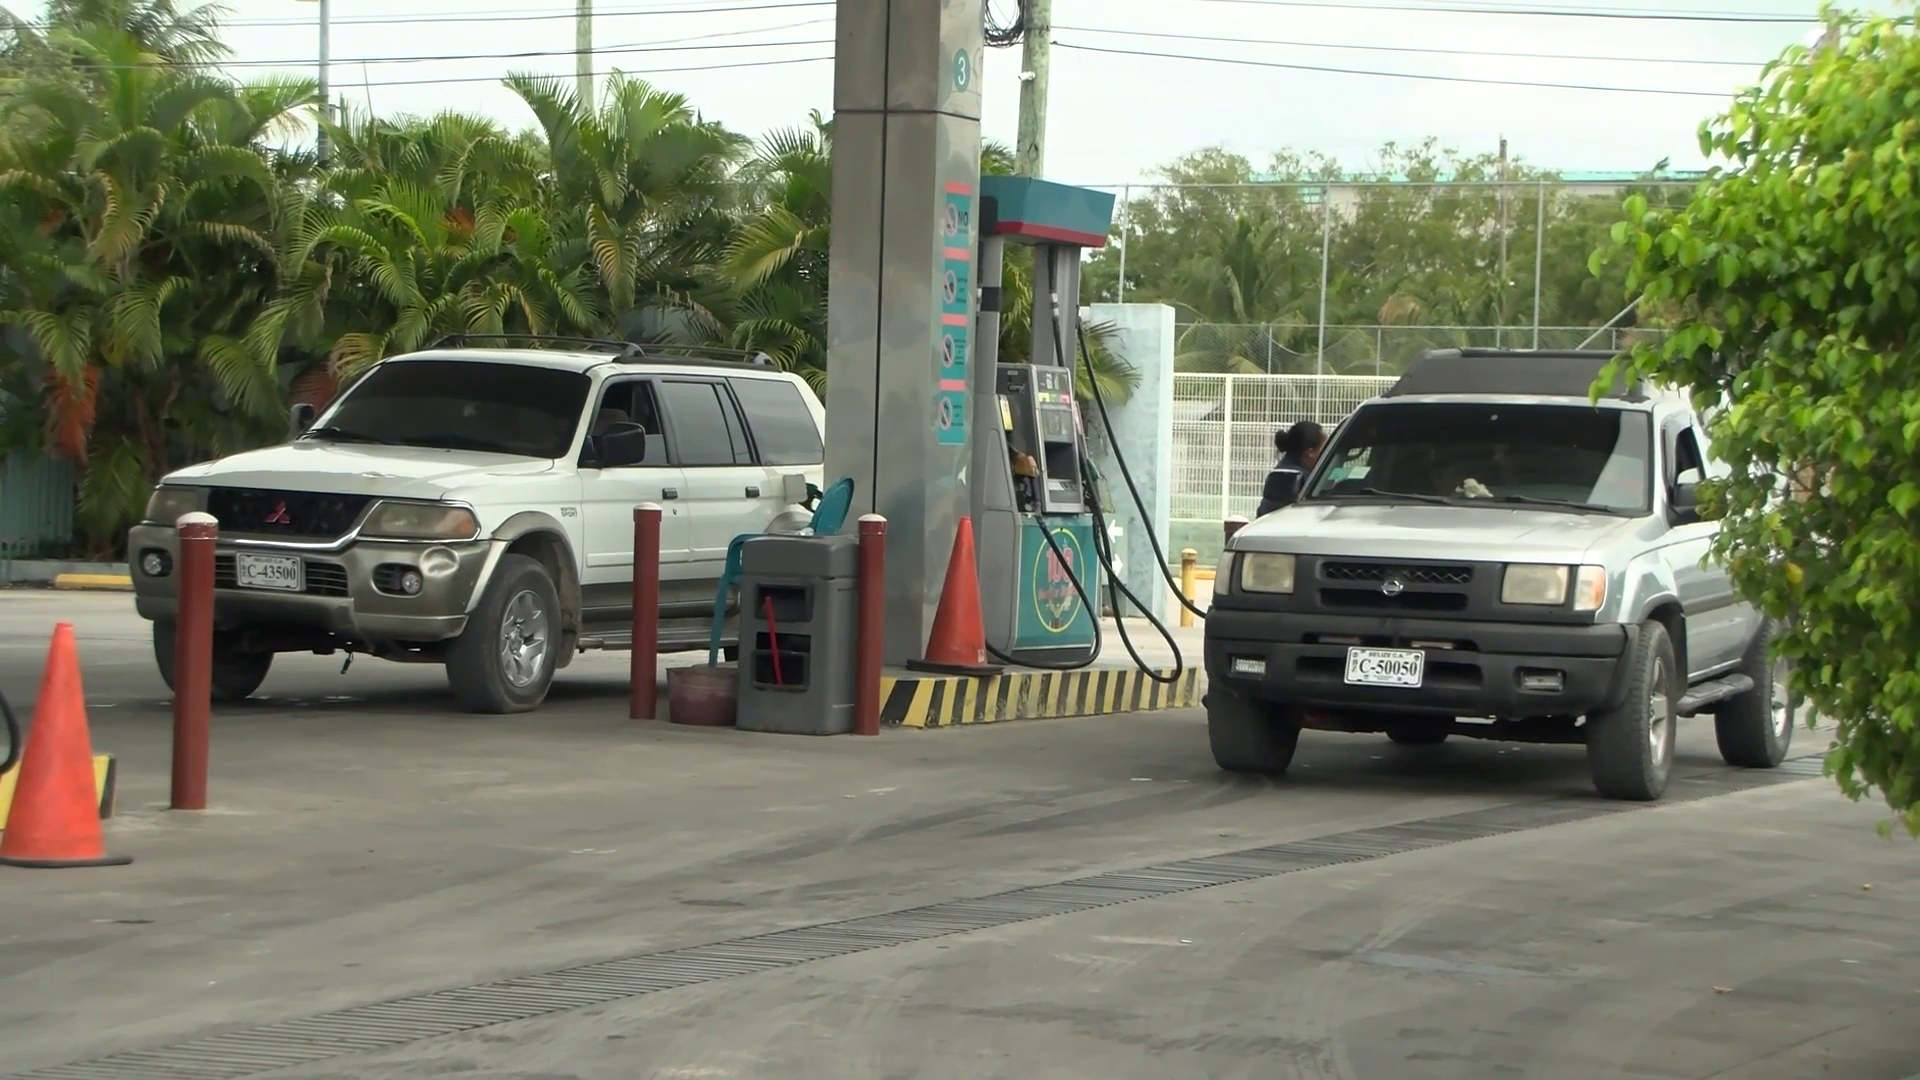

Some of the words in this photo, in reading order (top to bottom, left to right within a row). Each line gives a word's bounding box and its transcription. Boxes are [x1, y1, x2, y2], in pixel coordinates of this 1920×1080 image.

[957, 56, 966, 86] 3
[957, 210, 969, 226] NO
[247, 564, 296, 581] C-43500
[1359, 658, 1418, 676] C-50050
